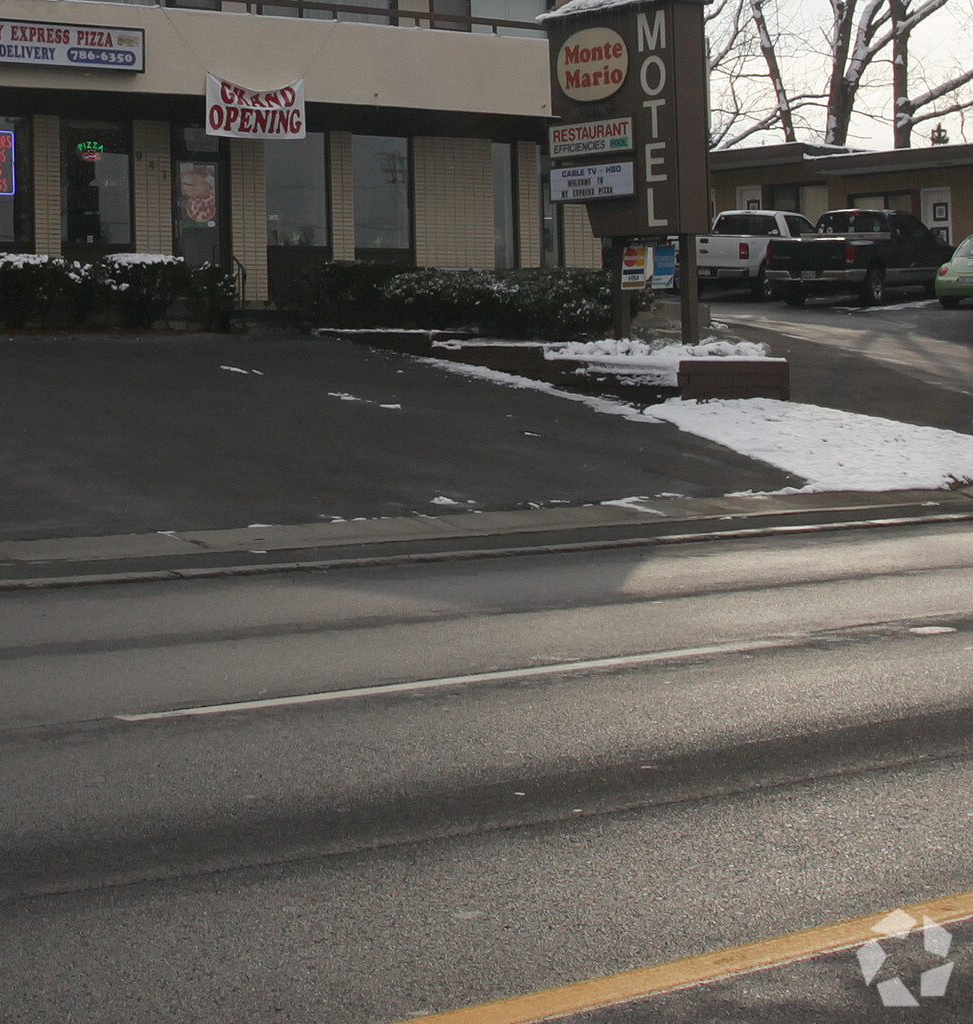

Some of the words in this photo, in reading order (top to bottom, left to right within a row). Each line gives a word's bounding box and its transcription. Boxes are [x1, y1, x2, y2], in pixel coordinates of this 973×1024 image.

[10, 26, 70, 45] EXPRESS
[76, 31, 114, 48] PIZZA
[70, 48, 133, 64] 786-6350
[564, 41, 623, 66] Monte
[565, 65, 623, 90] Mario
[220, 81, 296, 107] GRAND
[209, 104, 302, 134] OPENING
[636, 9, 668, 228] MOTEL
[553, 122, 629, 144] RESTAURANT
[77, 141, 104, 153] PIZZA
[553, 140, 606, 155] EFFICIENCIES
[561, 169, 585, 178] CABLE
[606, 165, 622, 174] HBO
[597, 177, 604, 185] TO
